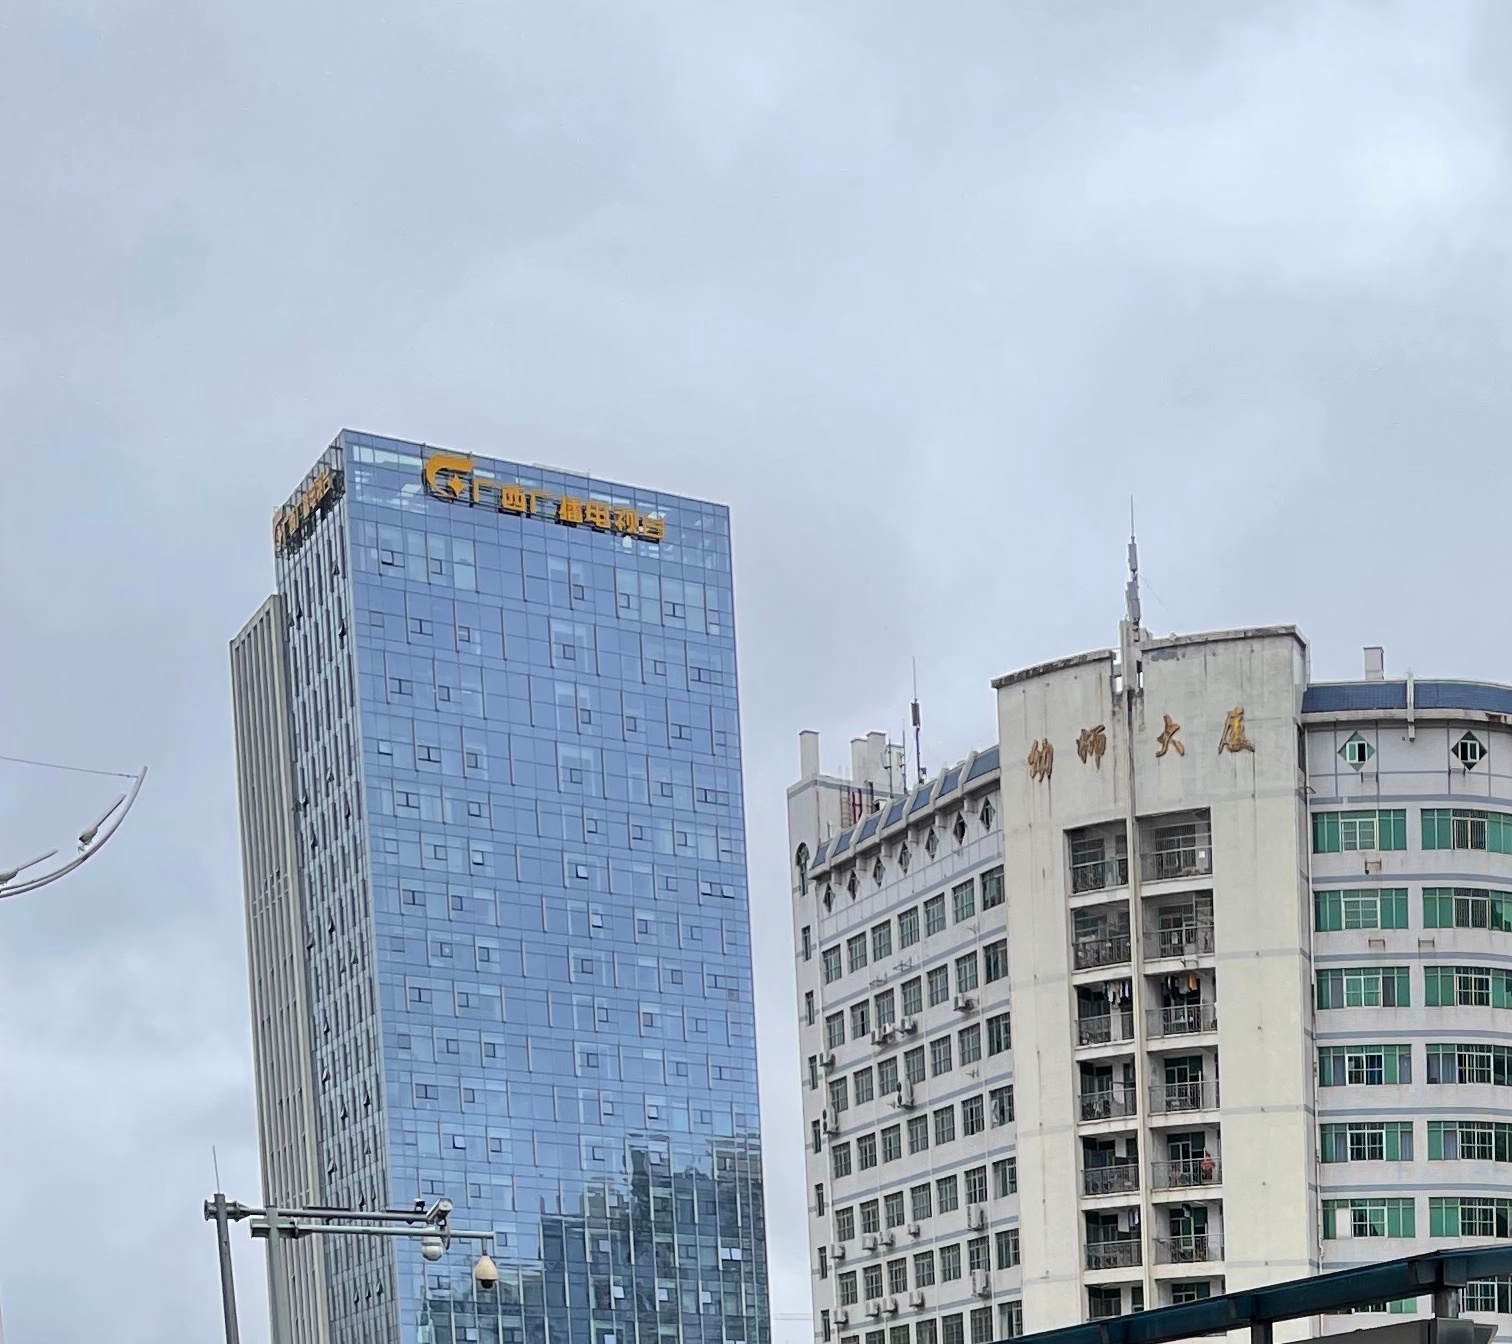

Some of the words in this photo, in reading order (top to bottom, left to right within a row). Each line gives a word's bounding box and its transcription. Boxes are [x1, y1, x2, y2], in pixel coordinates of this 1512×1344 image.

[473, 477, 665, 540] 广西广播电视台
[1027, 706, 1256, 784] 幼师大厦
